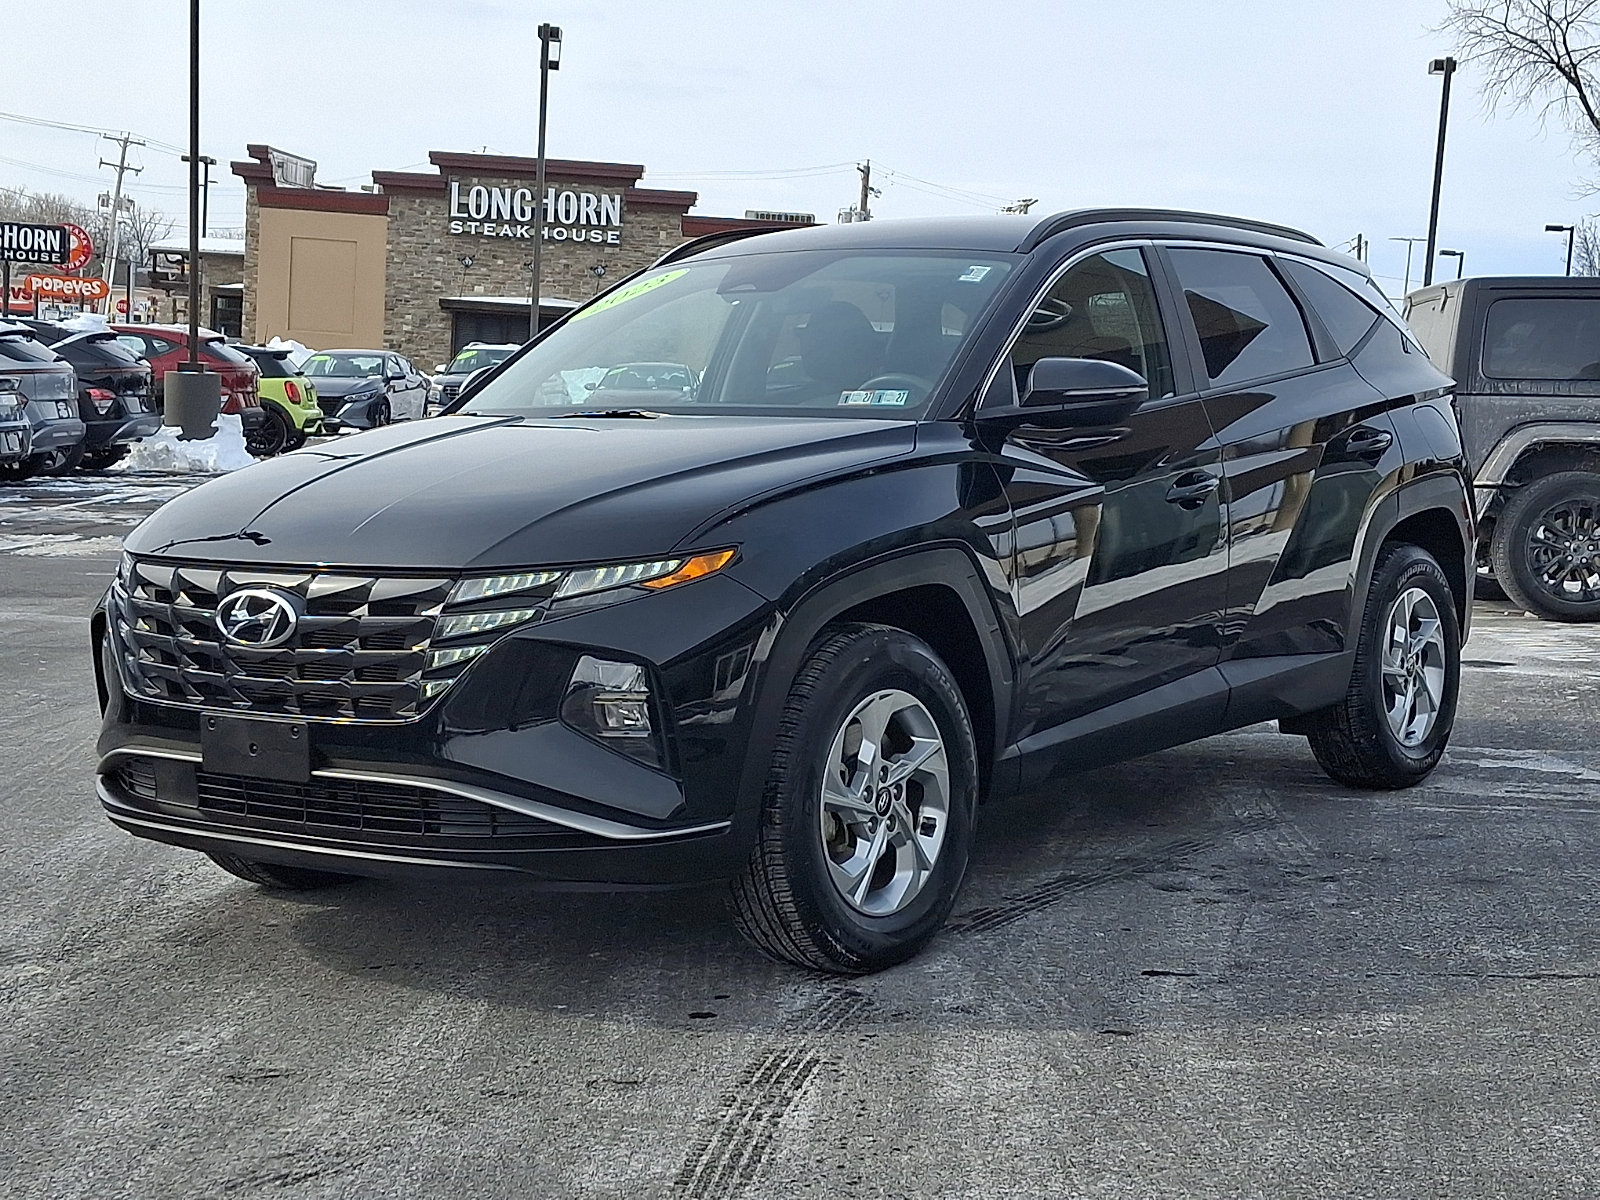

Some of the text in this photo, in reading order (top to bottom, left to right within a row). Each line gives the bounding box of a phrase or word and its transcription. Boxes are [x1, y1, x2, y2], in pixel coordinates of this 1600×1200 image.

[450, 181, 623, 227] LONGHORN
[0, 224, 61, 252] HORN
[450, 220, 621, 244] STEAKHOUSE
